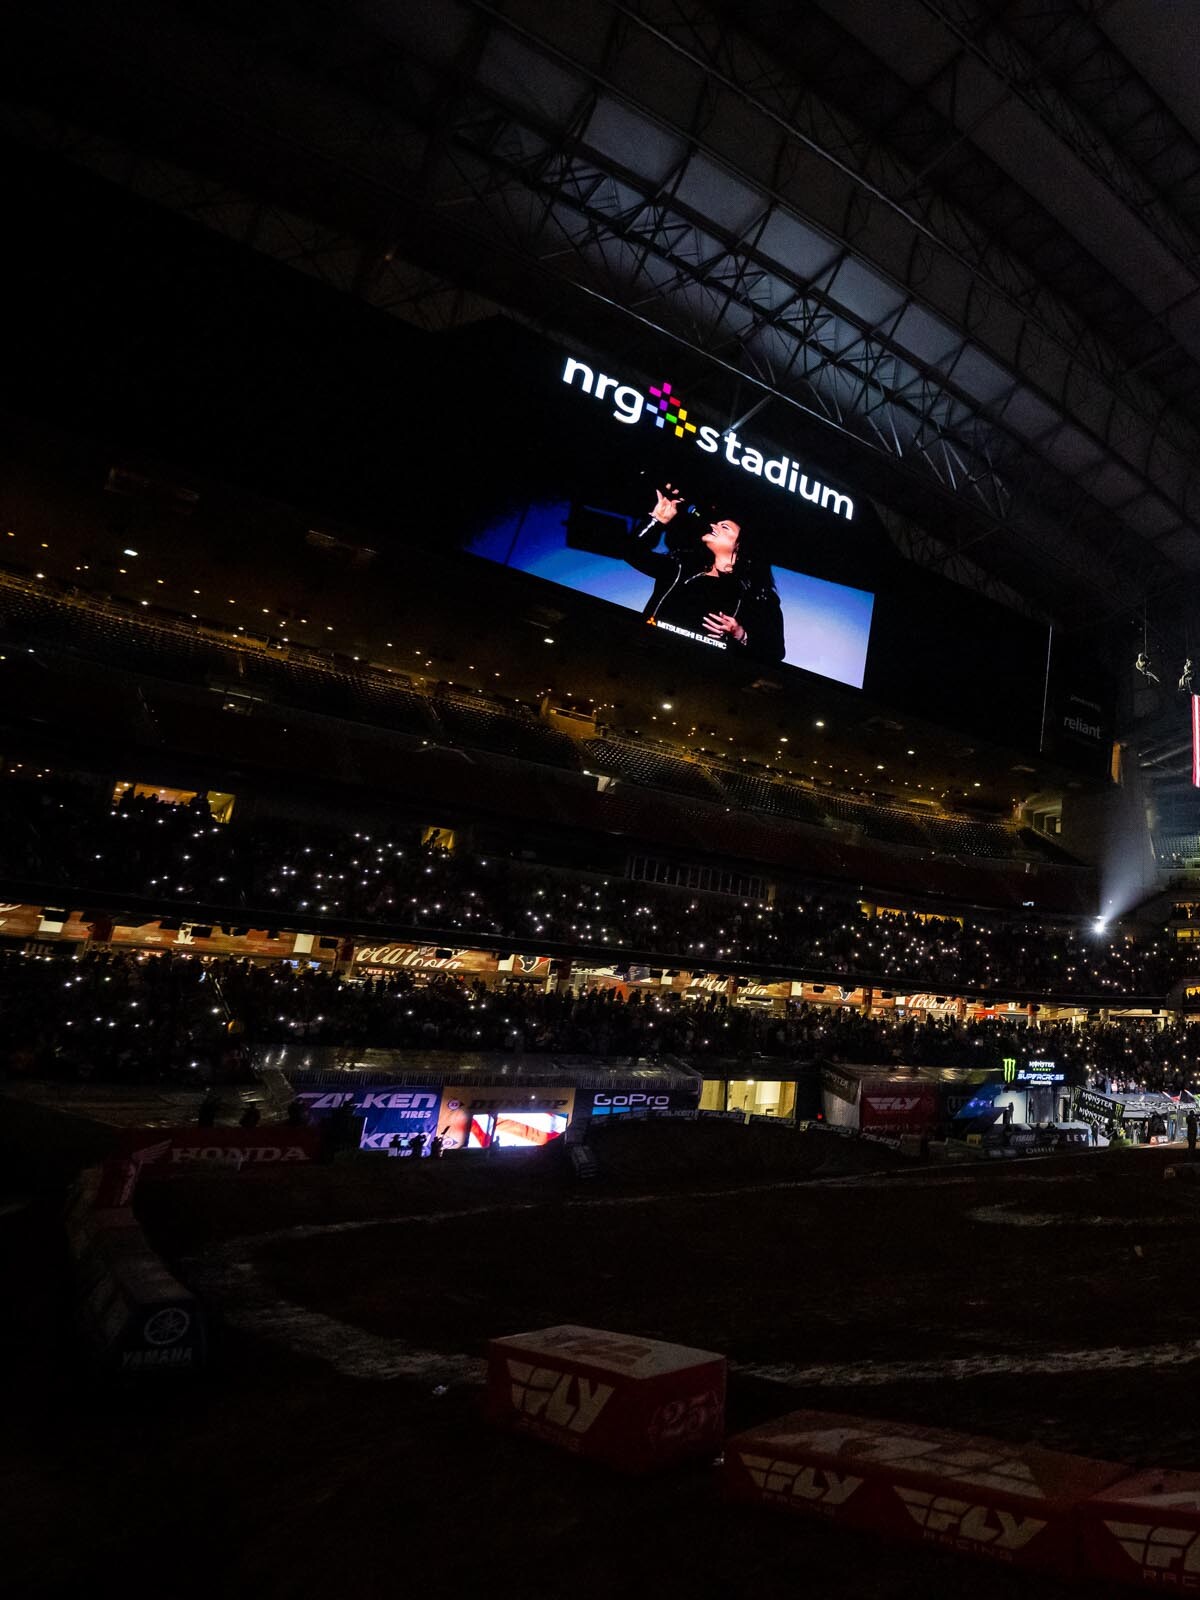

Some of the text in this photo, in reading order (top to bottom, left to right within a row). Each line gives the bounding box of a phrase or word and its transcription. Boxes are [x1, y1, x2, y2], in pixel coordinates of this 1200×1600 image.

[562, 357, 855, 520] nrg stadium
[695, 633, 727, 650] ELECTRIC
[593, 1093, 670, 1106] GoPro
[1082, 1092, 1113, 1110] MONSTER
[400, 1110, 433, 1118] TIRES
[169, 1146, 312, 1164] HONDA
